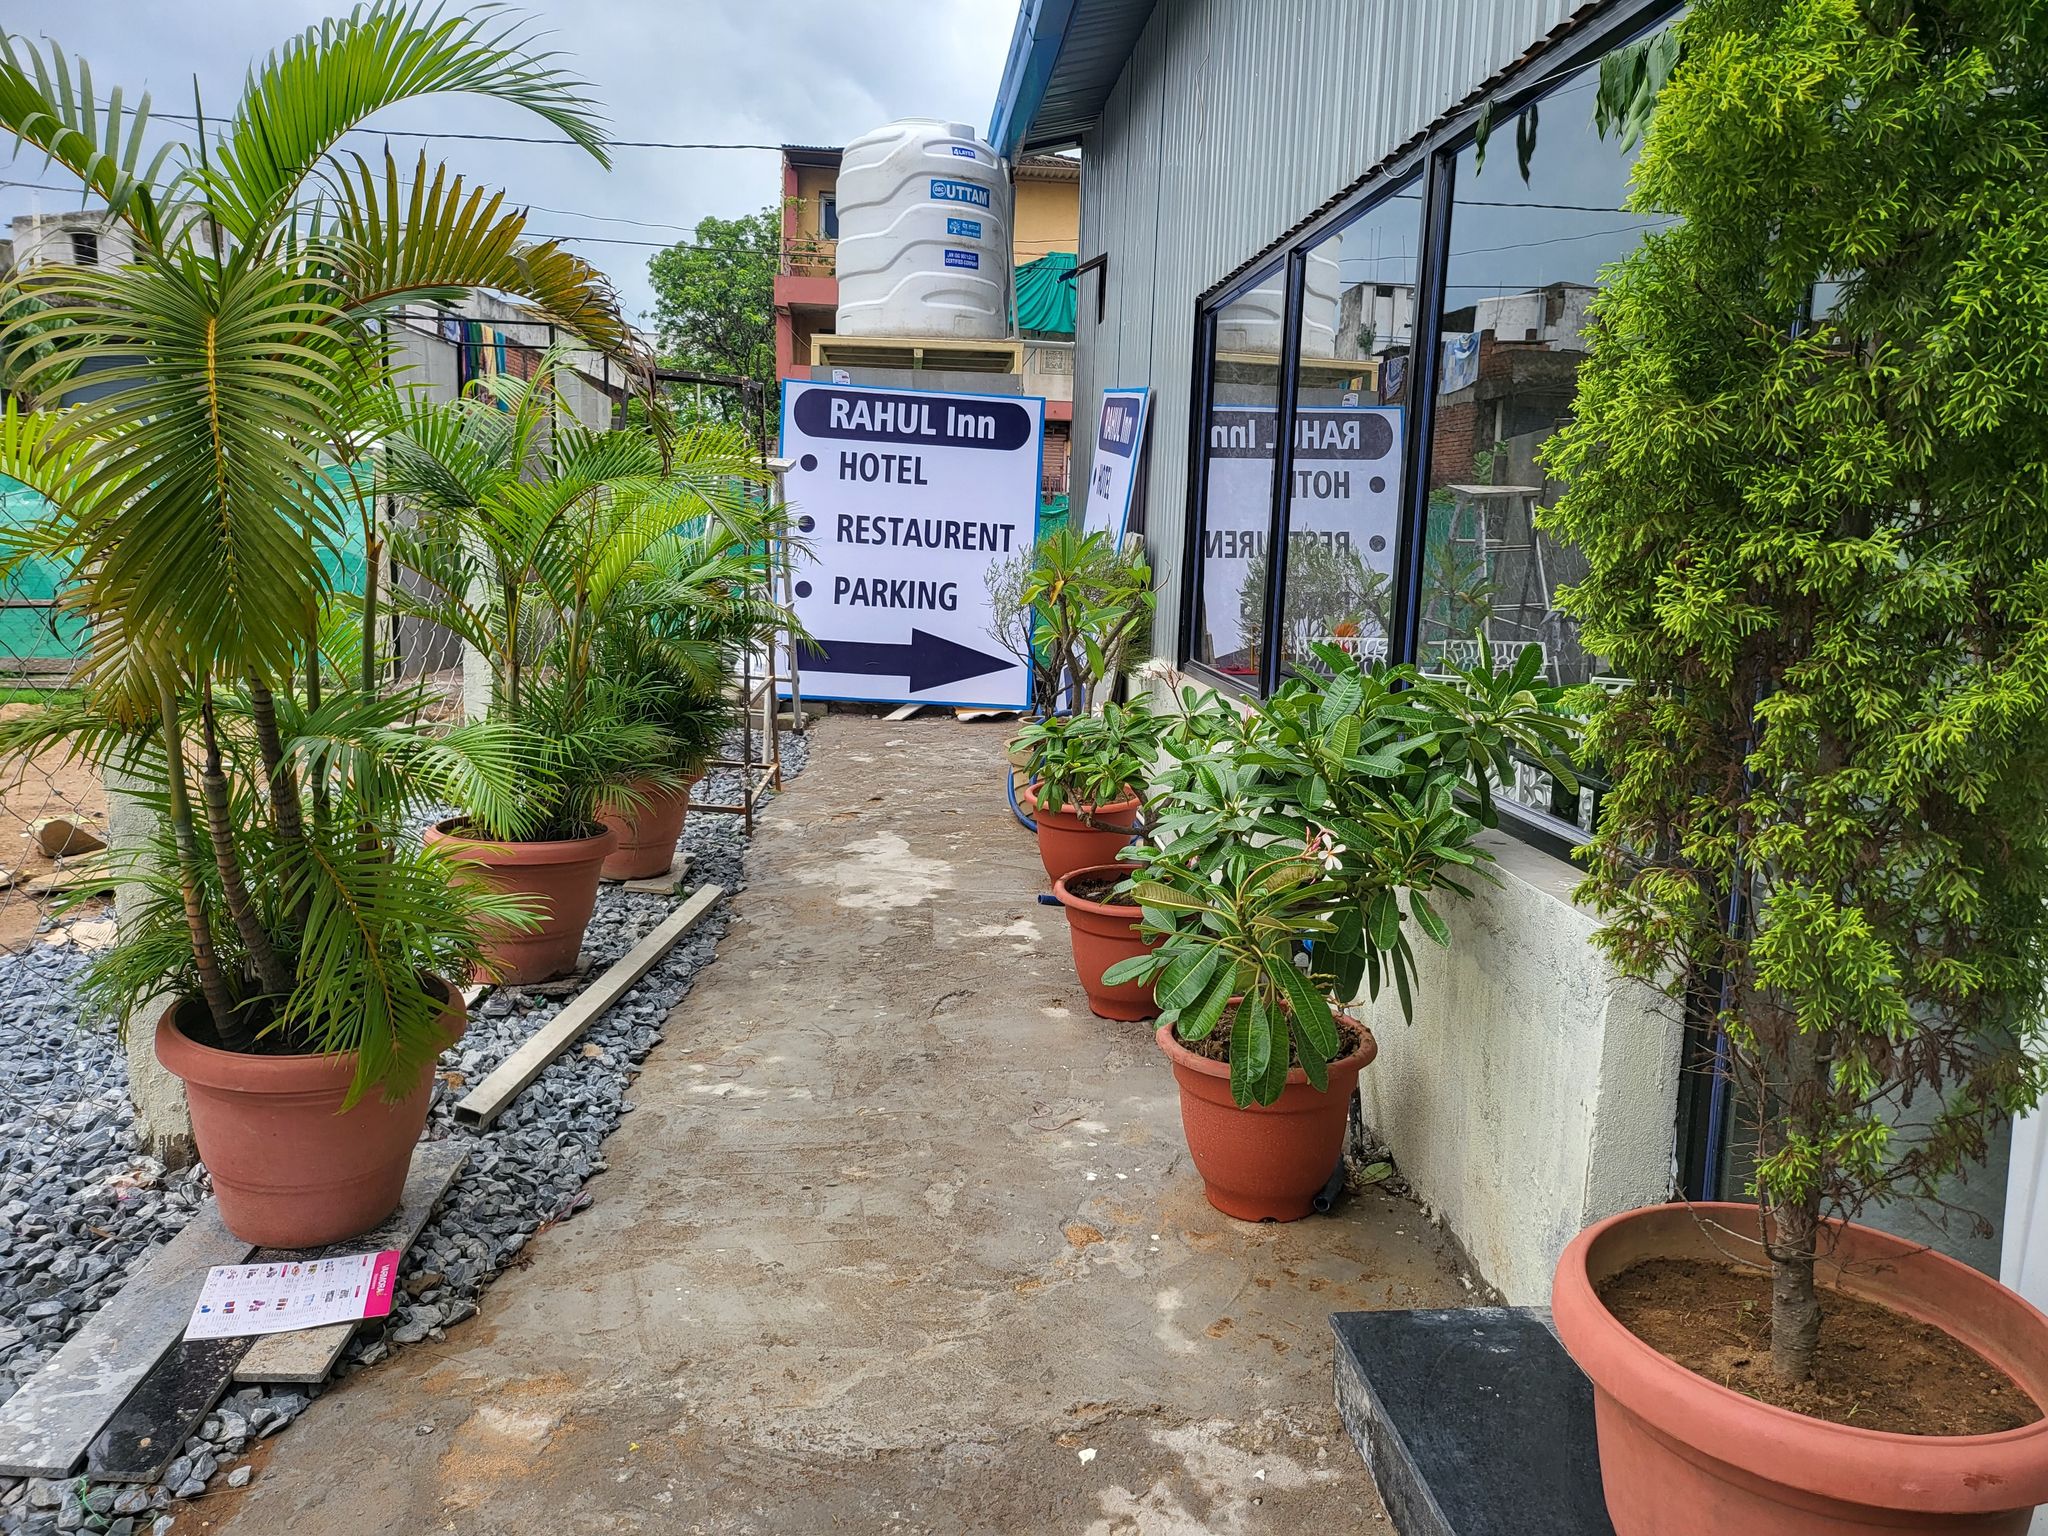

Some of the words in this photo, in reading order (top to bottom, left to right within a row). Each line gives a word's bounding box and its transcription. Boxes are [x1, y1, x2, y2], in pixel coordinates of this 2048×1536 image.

[946, 184, 988, 206] UTTAM
[829, 397, 937, 435] RAHUL
[946, 406, 996, 440] Inn
[839, 451, 928, 485] HOTEL
[836, 513, 1016, 553] RESTAURENT
[833, 576, 958, 611] PARKING
